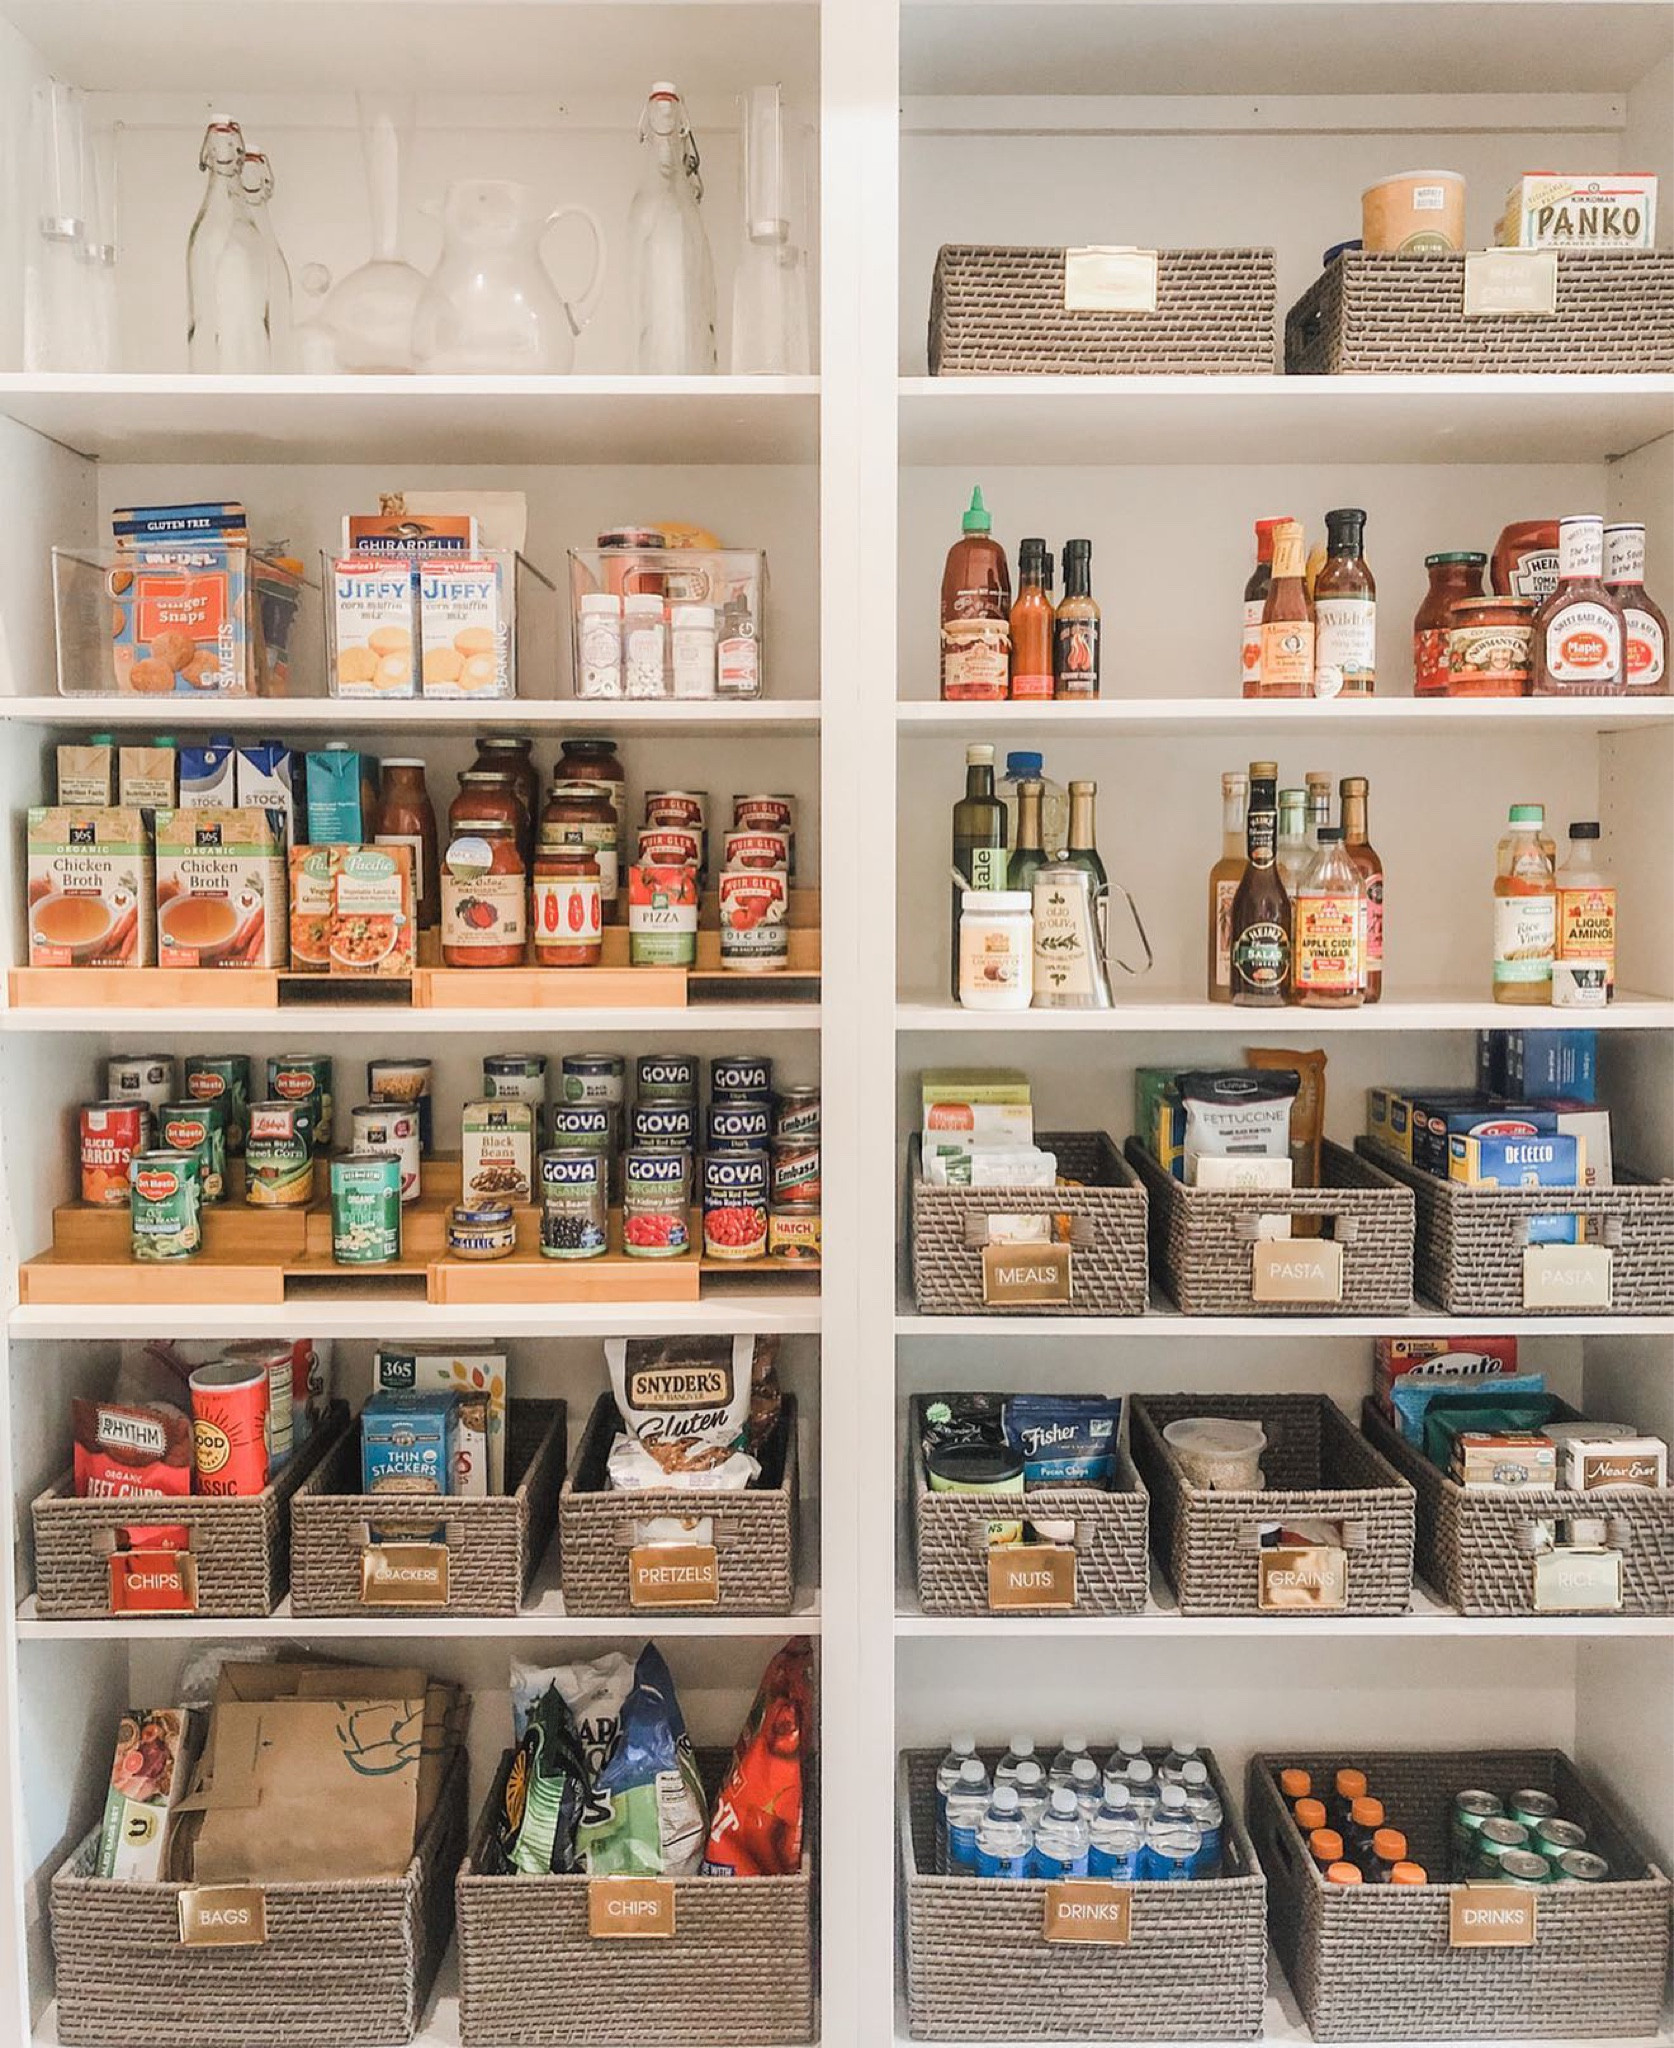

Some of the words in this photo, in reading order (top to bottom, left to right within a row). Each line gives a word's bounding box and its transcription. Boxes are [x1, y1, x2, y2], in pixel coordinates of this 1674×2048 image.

[1537, 206, 1641, 237] PANKO
[147, 520, 185, 531] GLUTEN
[187, 518, 211, 529] FREE
[358, 539, 463, 550] GHIRARDELLI
[338, 579, 406, 600] JIFFY
[423, 579, 491, 600] JIFFY
[452, 600, 489, 611] muffin
[159, 609, 206, 626] Snaps
[218, 623, 235, 688] SWEETS
[1568, 642, 1603, 655] Maple
[62, 789, 87, 797] Nutrition
[88, 789, 105, 797] Facts
[245, 794, 286, 806] STOCK
[192, 798, 223, 807] STOCK
[73, 831, 92, 842] 365
[200, 832, 218, 843] 365
[666, 835, 692, 848] GLEN
[56, 845, 111, 853] ORGANIC
[183, 847, 235, 855] ORGANIC
[756, 839, 781, 851] GLEN
[53, 858, 112, 872] Chicken
[180, 860, 238, 873] Chicken
[348, 855, 391, 871] Pacific
[62, 873, 103, 887] Broth
[190, 875, 230, 888] Broth
[725, 879, 748, 890] MUIR
[752, 878, 778, 891] GLEN
[642, 912, 679, 924] PIZZA
[1046, 907, 1069, 917] OLIO
[1575, 918, 1611, 928] LIQUID
[726, 931, 778, 941] DICED
[1249, 927, 1283, 942] HEINZ
[1569, 928, 1613, 939] AMINOS
[1303, 938, 1327, 948] APPLE
[1309, 948, 1350, 958] VINEGAR
[642, 1065, 691, 1083] GOYA
[715, 1068, 766, 1088] GOYA
[556, 1113, 606, 1133] GOYA
[636, 1112, 690, 1134] GOYA
[713, 1114, 767, 1135] GOYA
[781, 1111, 818, 1134] Embasa
[1203, 1110, 1285, 1125] FETTUCCINE
[84, 1139, 114, 1149] SLICED
[482, 1136, 514, 1148] Black
[274, 1148, 303, 1158] Corn
[481, 1148, 515, 1158] Beans
[1505, 1145, 1520, 1164] DE
[1521, 1144, 1554, 1163] CECCO
[543, 1162, 595, 1182] GOYA
[629, 1161, 681, 1180] GOYA
[707, 1163, 763, 1184] GOYA
[778, 1160, 817, 1183] Embasa
[565, 1200, 592, 1208] Beans
[777, 1223, 812, 1235] HATCH
[999, 1266, 1057, 1284] MEALS
[1269, 1263, 1325, 1280] PASTA
[1541, 1270, 1594, 1286] PASTA
[382, 1360, 412, 1378] 365
[637, 1372, 722, 1395] SNYDER'S
[637, 1409, 729, 1438] Gluten
[102, 1417, 160, 1446] RHYTHM
[1020, 1422, 1079, 1457] Fisher
[388, 1451, 420, 1462] THIN
[104, 1469, 143, 1484] ORGANIC
[372, 1462, 437, 1477] STACKERS
[1041, 1467, 1064, 1477] Pecan
[1065, 1466, 1089, 1478] Chips
[1587, 1461, 1629, 1479] Near
[1629, 1461, 1656, 1478] East
[126, 1574, 180, 1590] CHIPS
[375, 1568, 438, 1582] CRACKERS
[639, 1566, 713, 1584] PRETZELS
[1009, 1571, 1052, 1588] NUTS
[1268, 1571, 1336, 1587] GRAINS
[1558, 1571, 1598, 1589] RICE
[105, 1825, 116, 1851] BAGS
[111, 1806, 119, 1823] SET
[607, 1900, 659, 1917] CHIPS
[1058, 1902, 1119, 1921] DRINKS
[200, 1908, 249, 1926] BAGS
[1463, 1908, 1525, 1927] DRINKS
